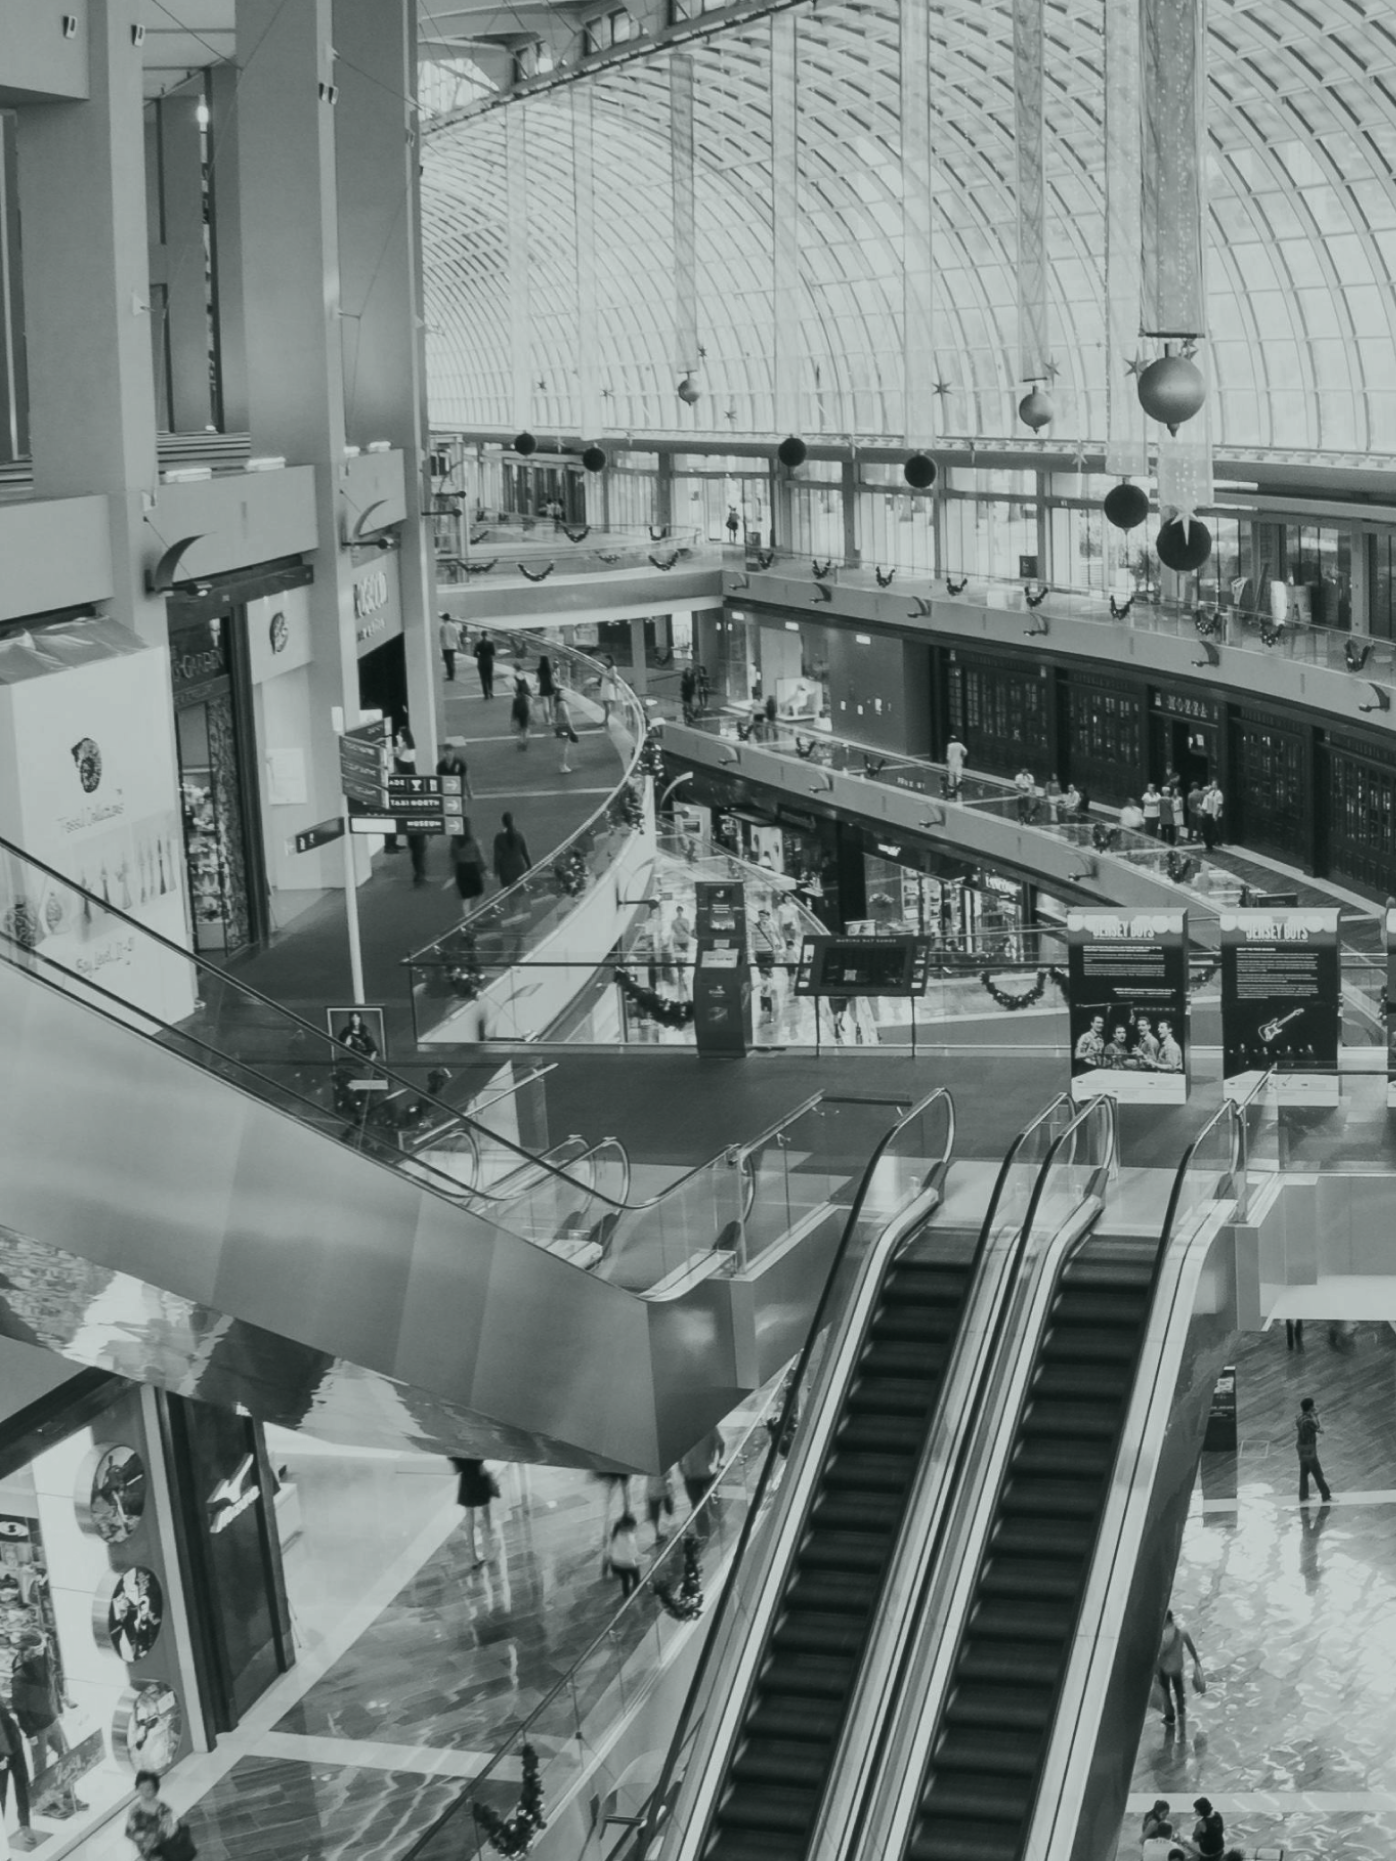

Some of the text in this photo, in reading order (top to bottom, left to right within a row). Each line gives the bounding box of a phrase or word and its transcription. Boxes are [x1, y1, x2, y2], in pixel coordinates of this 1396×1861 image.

[1092, 920, 1155, 938] JERSEY BOYS
[1246, 921, 1309, 940] JERSEY BOYS
